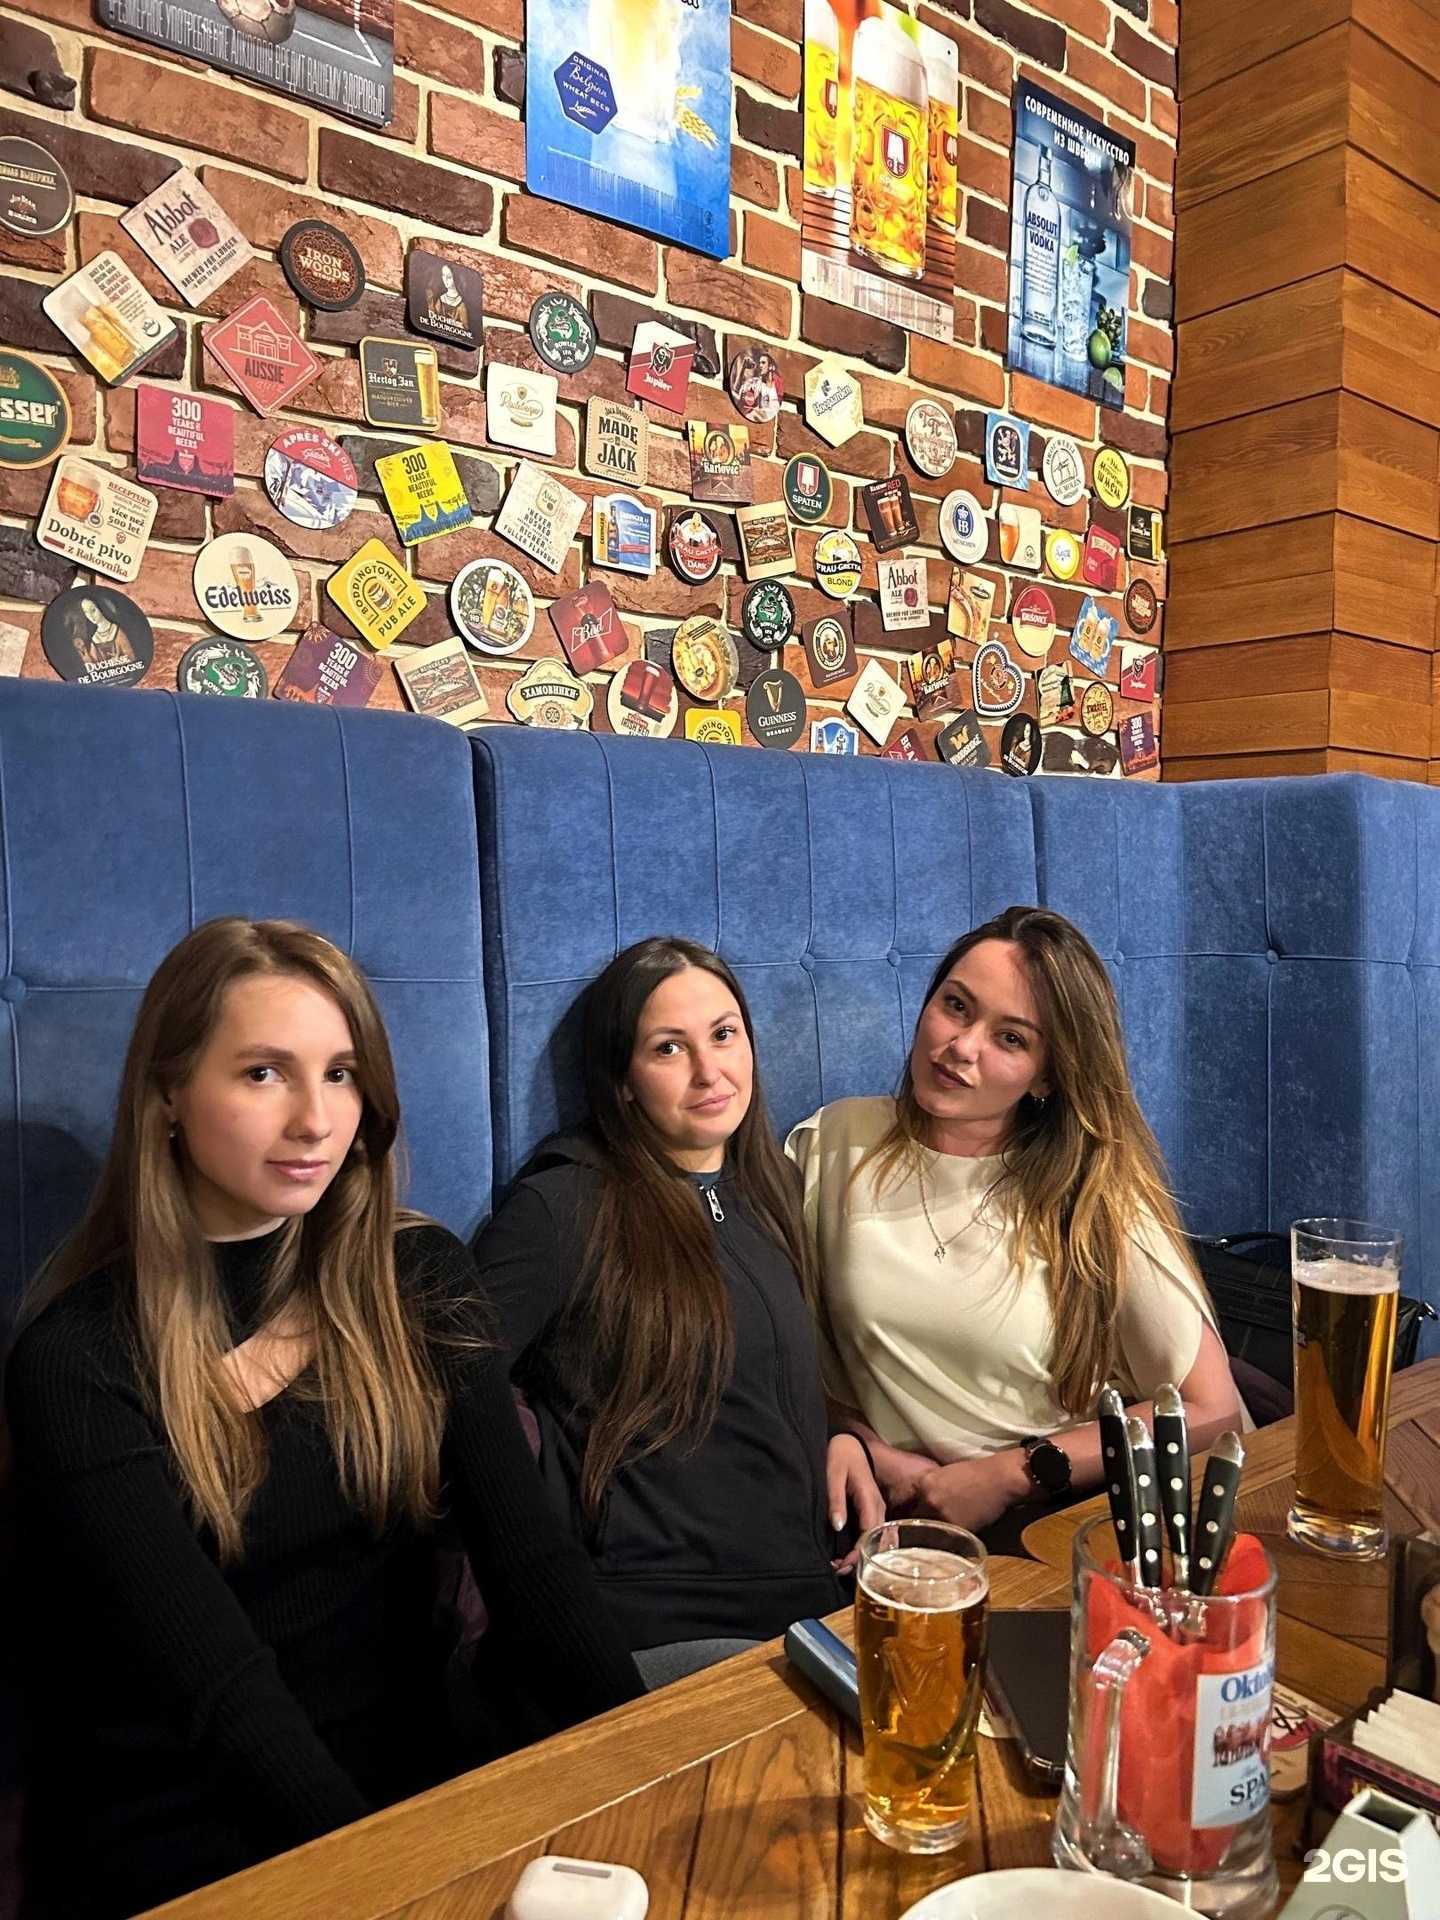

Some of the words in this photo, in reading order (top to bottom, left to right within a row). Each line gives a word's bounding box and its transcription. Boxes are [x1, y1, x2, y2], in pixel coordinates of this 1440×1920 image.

[570, 62, 607, 97] Belgian
[573, 55, 609, 82] ORIGINAL
[275, 44, 305, 93] ВРЕДИТ
[307, 57, 342, 101] ВАШЕМУ
[343, 70, 385, 118] ЗДОРОВЬЮ
[563, 80, 588, 99] WHEAT
[590, 97, 609, 112] BEER
[1025, 95, 1084, 140] СОВРЕМЕННОЕ
[1086, 129, 1130, 166] ИСКУССТВО
[1054, 130, 1065, 148] ИЗ
[144, 190, 200, 246] Abbot
[1027, 211, 1057, 236] ABSOLUT
[170, 233, 190, 255] ALE
[1029, 231, 1055, 253] VODKA
[203, 254, 217, 269] FOR
[299, 256, 350, 282] WOODS
[306, 247, 342, 269] IRON
[428, 310, 467, 329] DUCHESSE
[430, 317, 473, 339] BOURGOGNE
[245, 358, 285, 384] AUSSIE
[643, 373, 672, 392] Jupiler
[171, 396, 202, 422] 300
[168, 425, 205, 442] BEAUTIFUL
[172, 417, 195, 430] YEARS
[598, 415, 639, 446] MADE
[175, 436, 198, 449] BEERS
[282, 431, 320, 449] APRÈS
[321, 438, 341, 457] SKI
[402, 452, 427, 474] 300
[597, 442, 638, 473] JACK
[408, 471, 426, 484] YEARS
[408, 478, 438, 493] BEAUTIFUL
[416, 488, 434, 500] BEERS
[792, 494, 823, 510] SPATEN
[108, 515, 126, 528] 500
[957, 518, 969, 534] HB
[49, 518, 96, 550] Dobré
[97, 543, 133, 566] pivo
[67, 545, 75, 553] z
[76, 547, 129, 578] Rakovníka
[687, 560, 708, 569] DARK
[826, 576, 853, 587] BLOND
[888, 566, 918, 590] Abbot
[205, 584, 292, 609] Edelweiss
[352, 564, 399, 616] BODDINGTONS
[378, 615, 399, 637] PUB
[399, 596, 417, 617] ALE
[84, 654, 131, 673] DUCHESSE
[327, 656, 345, 675] YEARS
[330, 642, 358, 671] 300
[90, 661, 145, 684] BOURGOGNE
[318, 662, 348, 688] BEAUTIFUL
[320, 673, 340, 690] BEERS
[525, 684, 577, 699] ХАМОВНИКИ
[758, 711, 797, 728] GUINNESS
[766, 727, 793, 737] DRAUGHT
